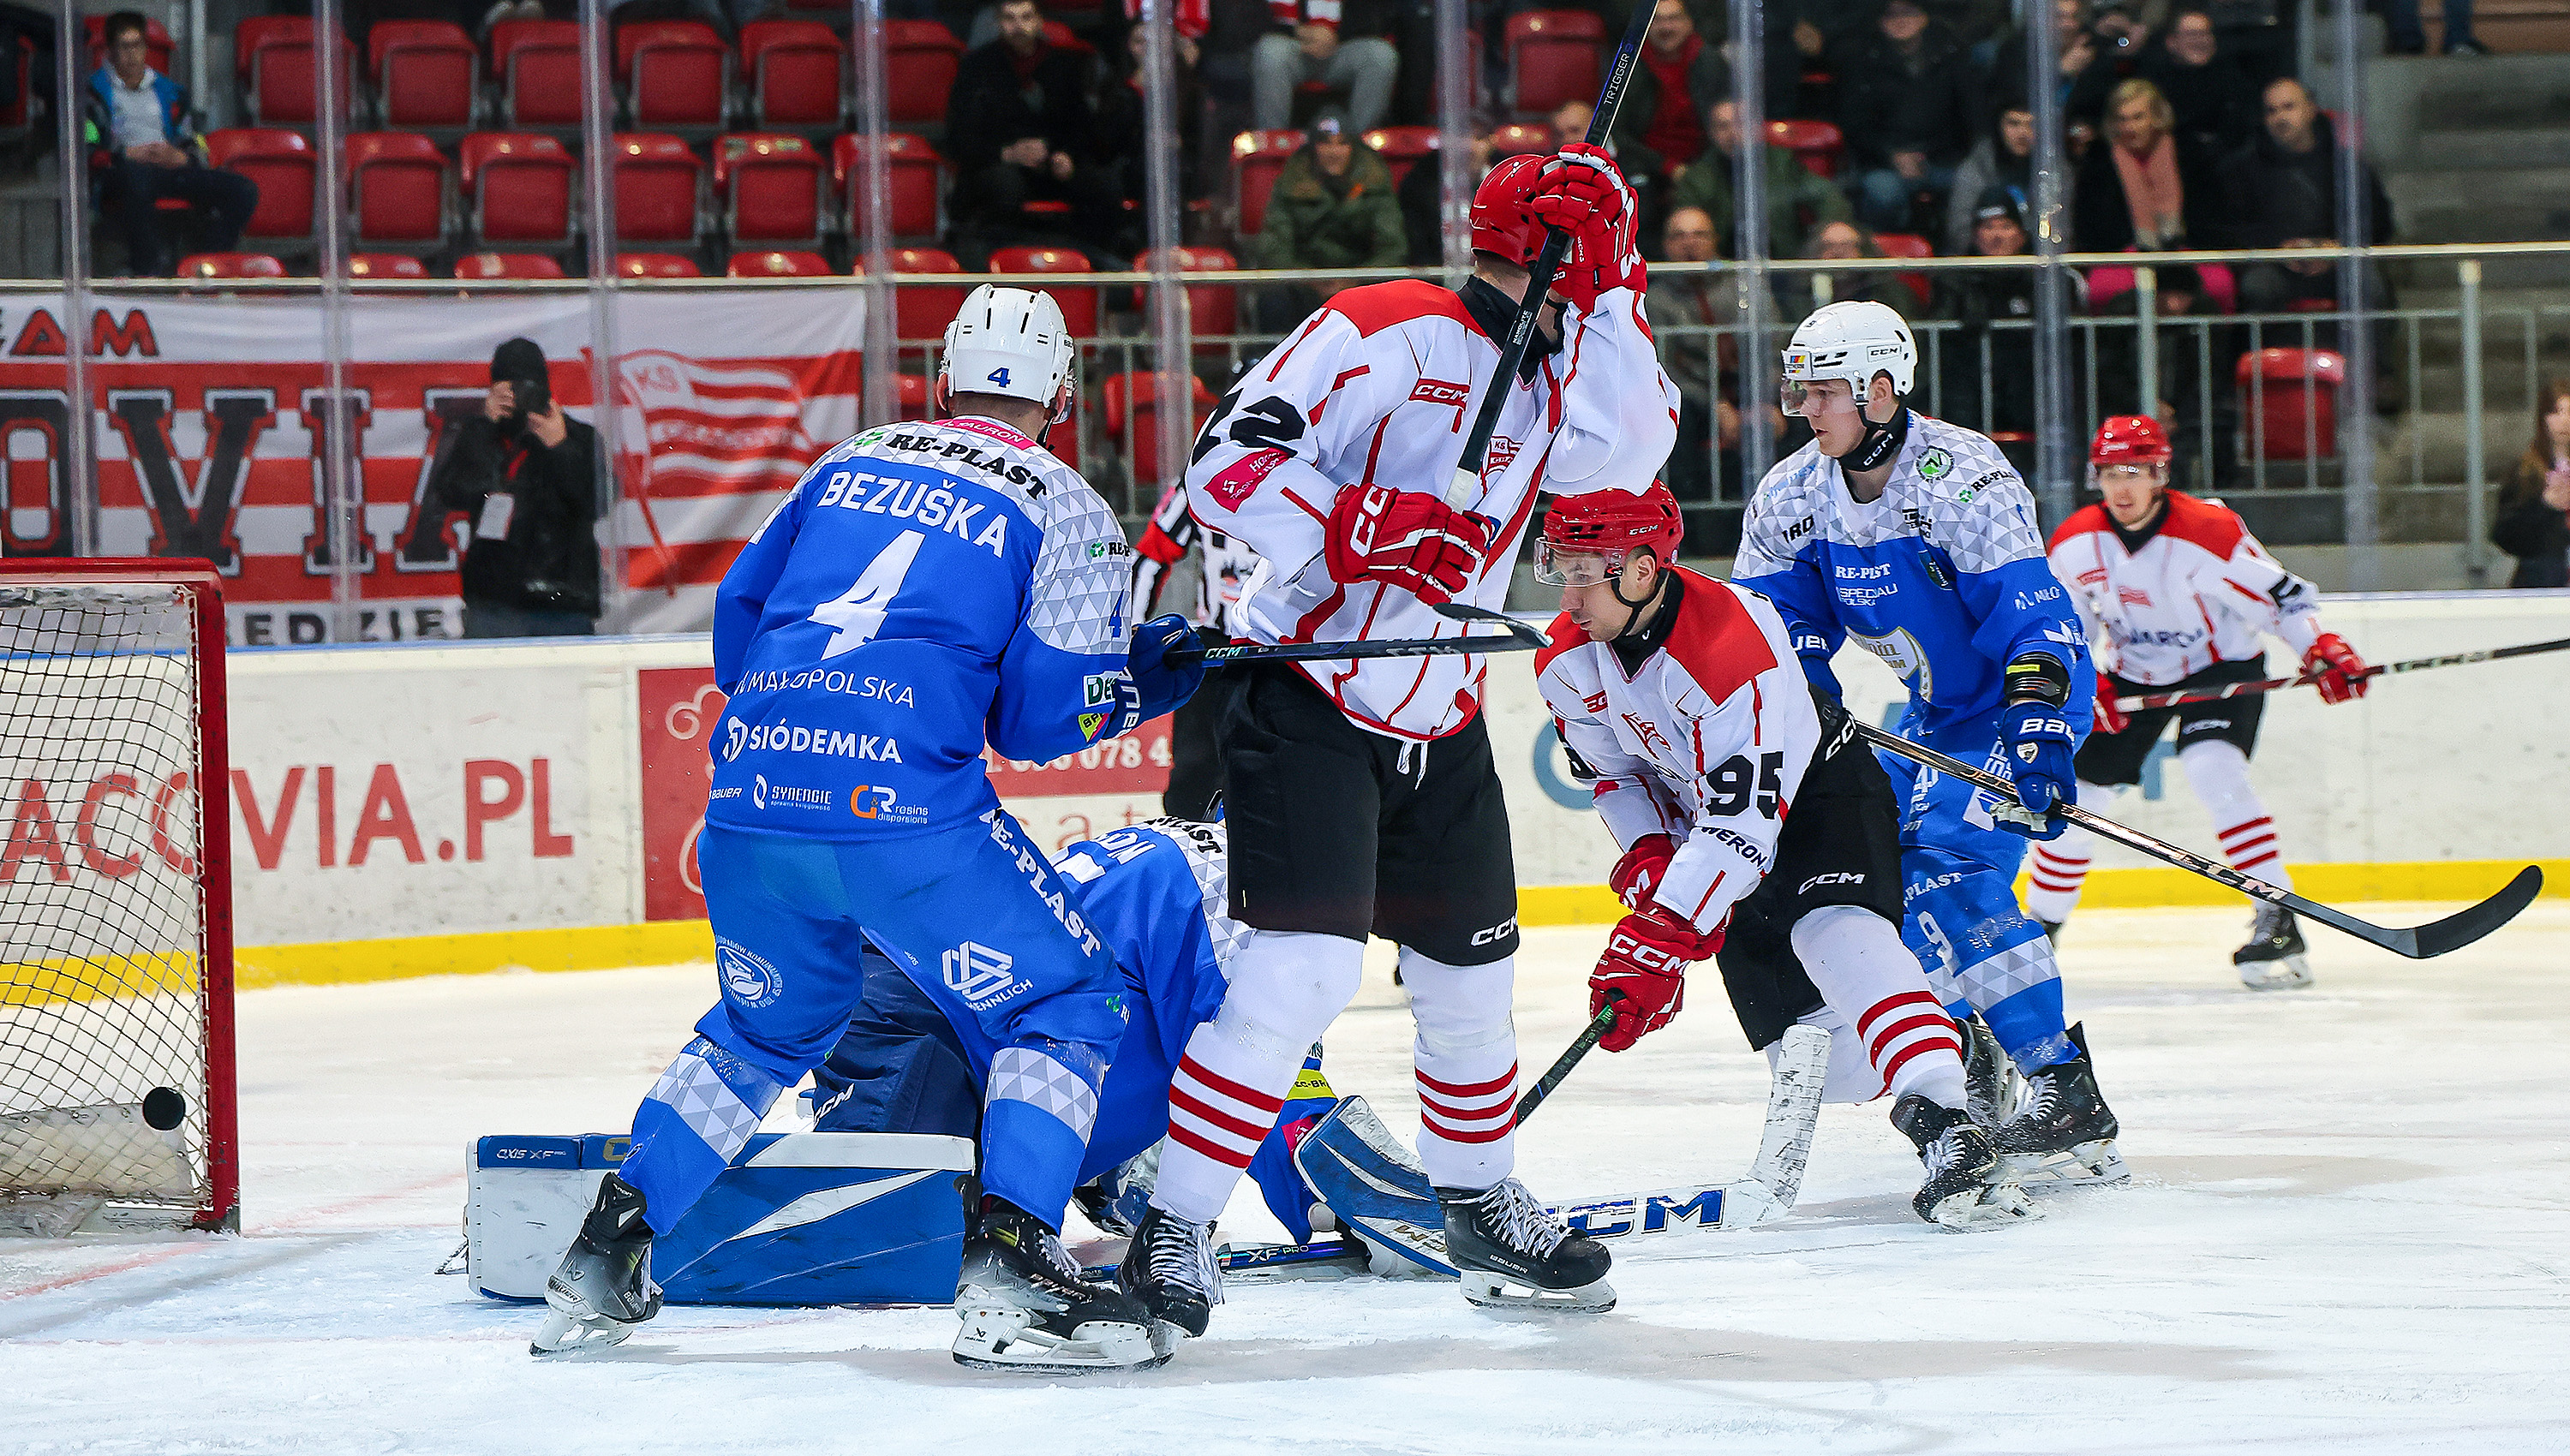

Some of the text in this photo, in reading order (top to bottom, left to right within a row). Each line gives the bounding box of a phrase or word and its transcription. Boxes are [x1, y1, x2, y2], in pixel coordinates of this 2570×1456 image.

[1603, 53, 1630, 104] TRIGGER
[0, 307, 160, 357] AM
[987, 367, 1012, 389] 4
[1414, 384, 1468, 403] CCM
[886, 434, 1048, 500] RE-PLAST
[1862, 433, 1894, 466] CCM
[817, 470, 1008, 558] BEZUŠKA
[1629, 525, 1659, 535] CCM
[806, 529, 926, 660] 4
[1108, 588, 1125, 638] 4
[224, 606, 448, 646] EDZIE
[1205, 647, 1243, 659] CCM
[749, 718, 903, 764] SIÓDEMKA
[1706, 751, 1784, 820] 95
[1798, 872, 1866, 895] CCM
[1610, 934, 1691, 976] CCM
[1545, 1187, 1725, 1239] CM
[1246, 1244, 1310, 1263] XF PRO
